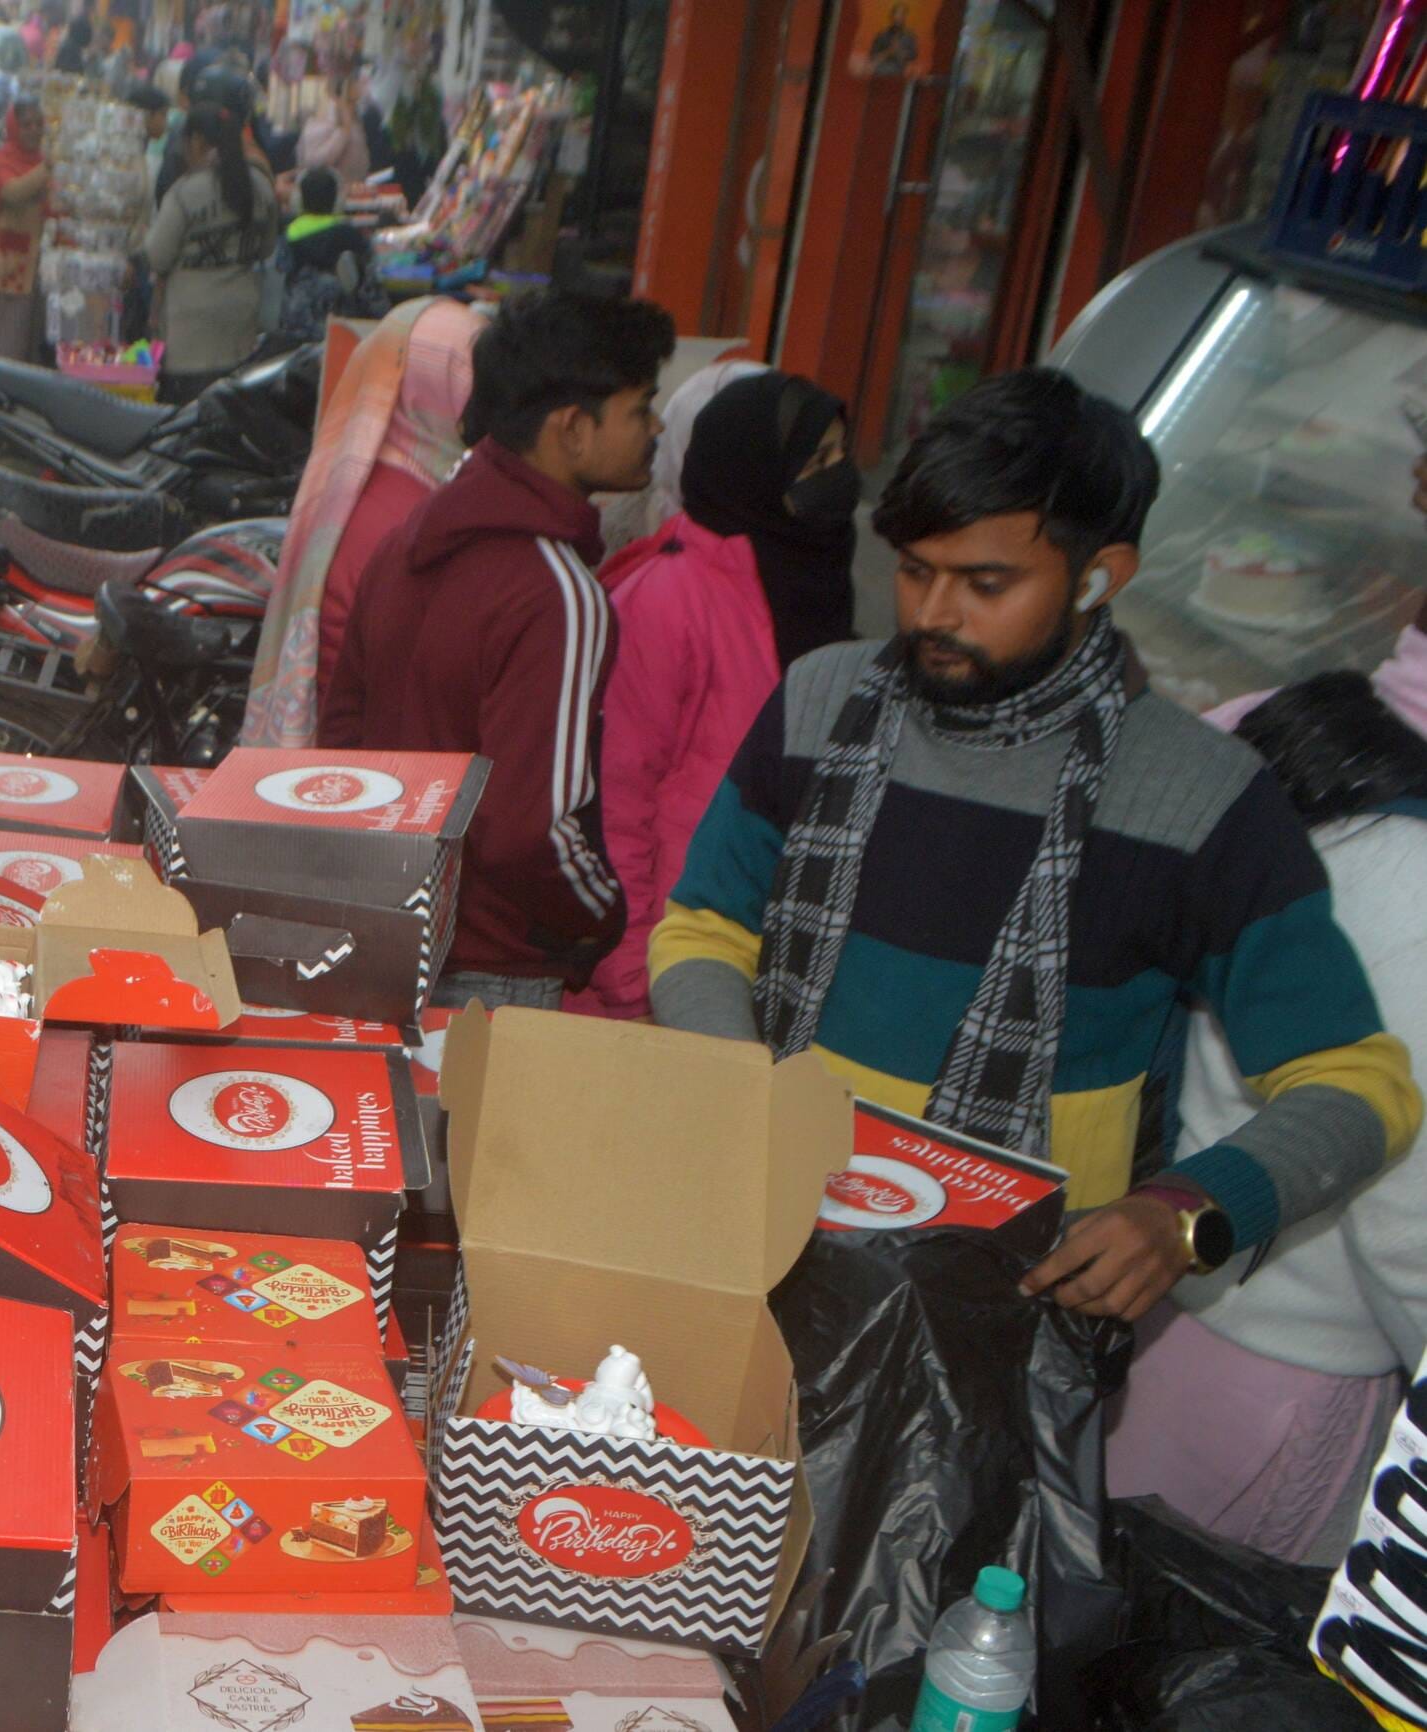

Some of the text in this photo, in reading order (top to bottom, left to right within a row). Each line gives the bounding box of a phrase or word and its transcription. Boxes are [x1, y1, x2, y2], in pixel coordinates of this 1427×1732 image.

[351, 1091, 393, 1169] happines
[301, 1132, 354, 1189] baked
[603, 1509, 643, 1522] HAPPY
[219, 1685, 278, 1695] DELICIOUS
[229, 1694, 271, 1703] CAKE &
[226, 1702, 277, 1713] PASTRIES
